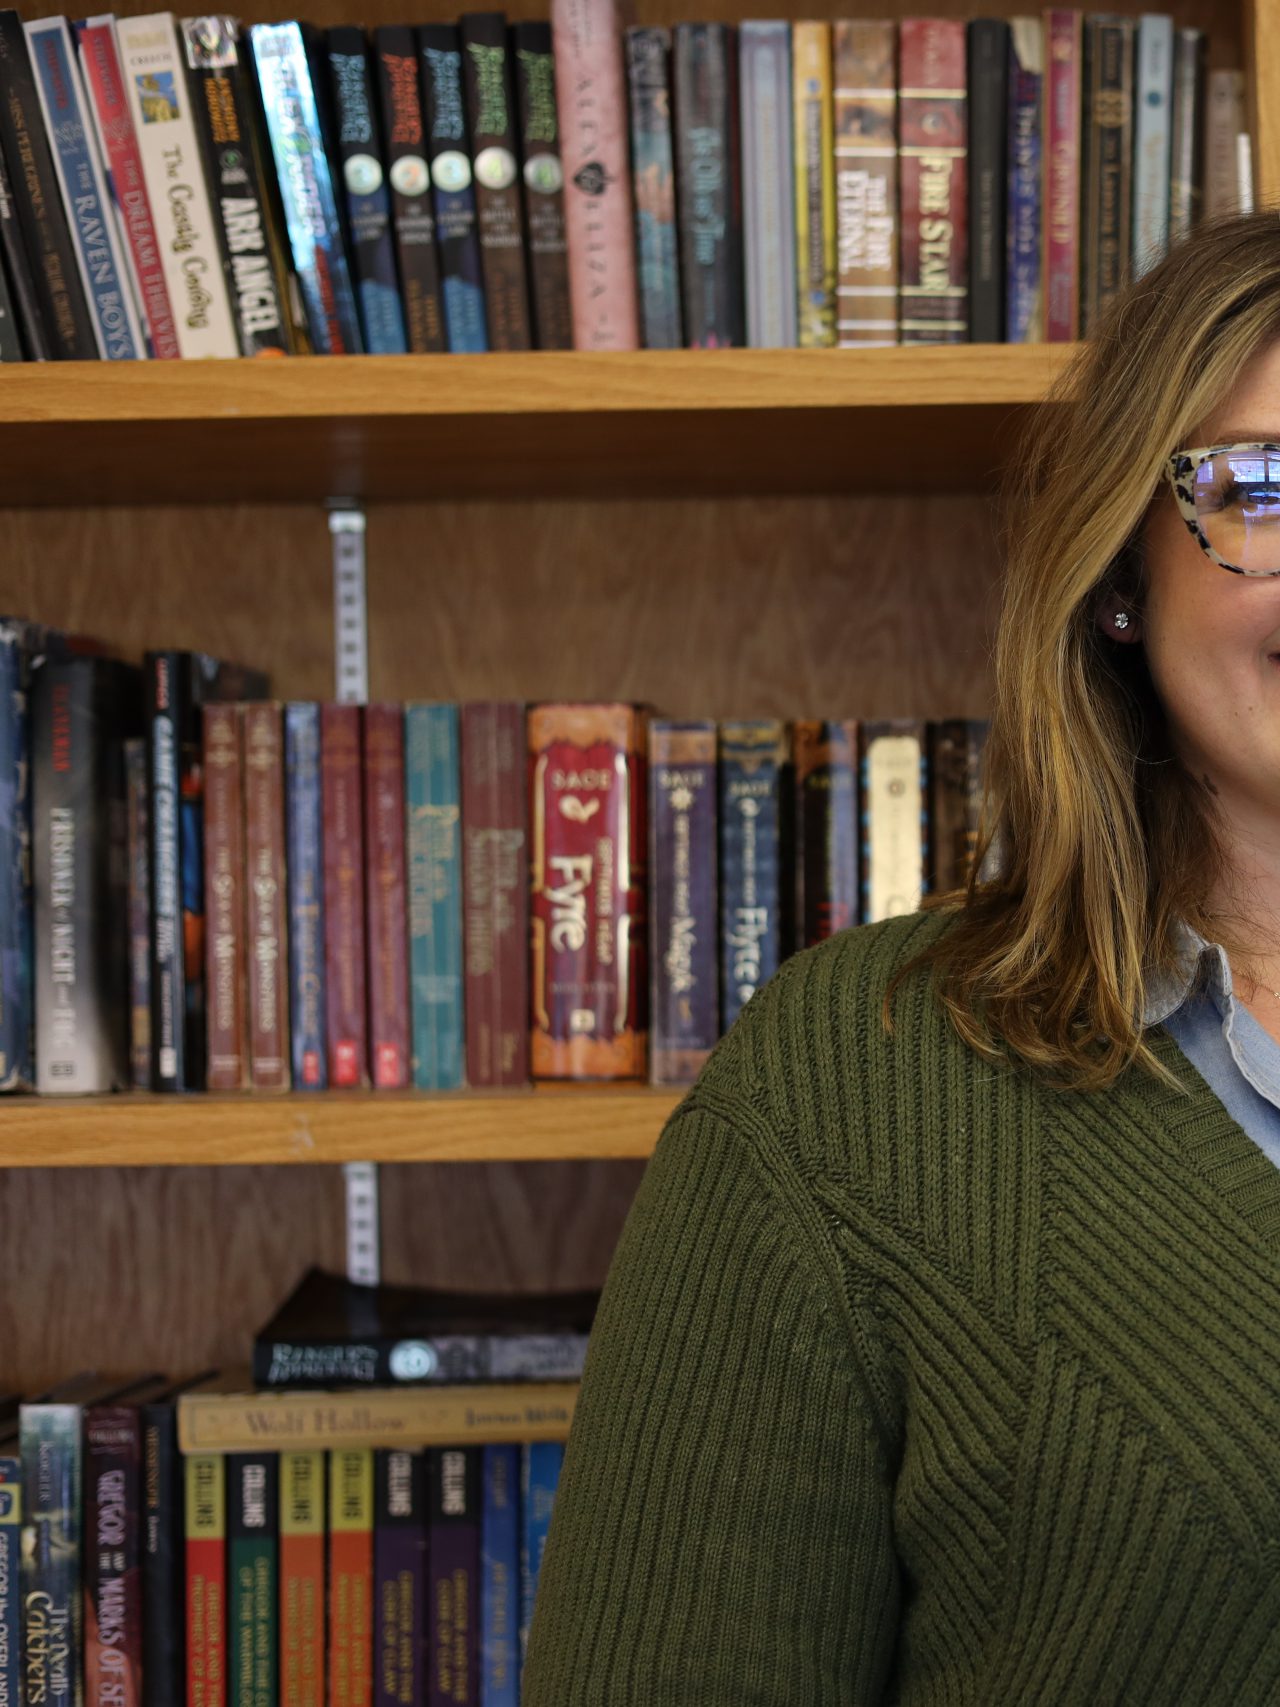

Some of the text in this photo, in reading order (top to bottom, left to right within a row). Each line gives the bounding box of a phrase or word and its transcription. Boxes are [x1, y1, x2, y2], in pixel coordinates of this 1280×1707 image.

[163, 145, 182, 178] The
[123, 191, 158, 267] DREAM
[692, 217, 726, 265] Time
[918, 156, 954, 292] FIRE STAR
[74, 196, 112, 284] RAVEN
[97, 292, 131, 359] BOYS
[220, 197, 280, 334] ARK ANGEL
[153, 715, 178, 915] GAME CHANGERS
[551, 770, 613, 790] SAGE
[50, 807, 75, 908] PRISONER
[596, 836, 613, 913] SEPTIMUS
[545, 855, 593, 953] Fyre
[52, 923, 76, 984] NIGHT
[213, 933, 237, 1030] MONSTERS
[726, 906, 769, 982] Flyte
[255, 934, 278, 1031] MONSTERS
[245, 1408, 407, 1436] Wolf Hollow
[97, 1470, 126, 1546] GREGOR
[242, 1464, 266, 1528] COLLINS
[25, 1591, 54, 1705] Catchers
[50, 1604, 70, 1696] The Death
[97, 1578, 127, 1646] MARKS
[191, 1575, 205, 1653] PROPHECY
[98, 1648, 127, 1680] OF
[98, 1683, 127, 1707] SE
